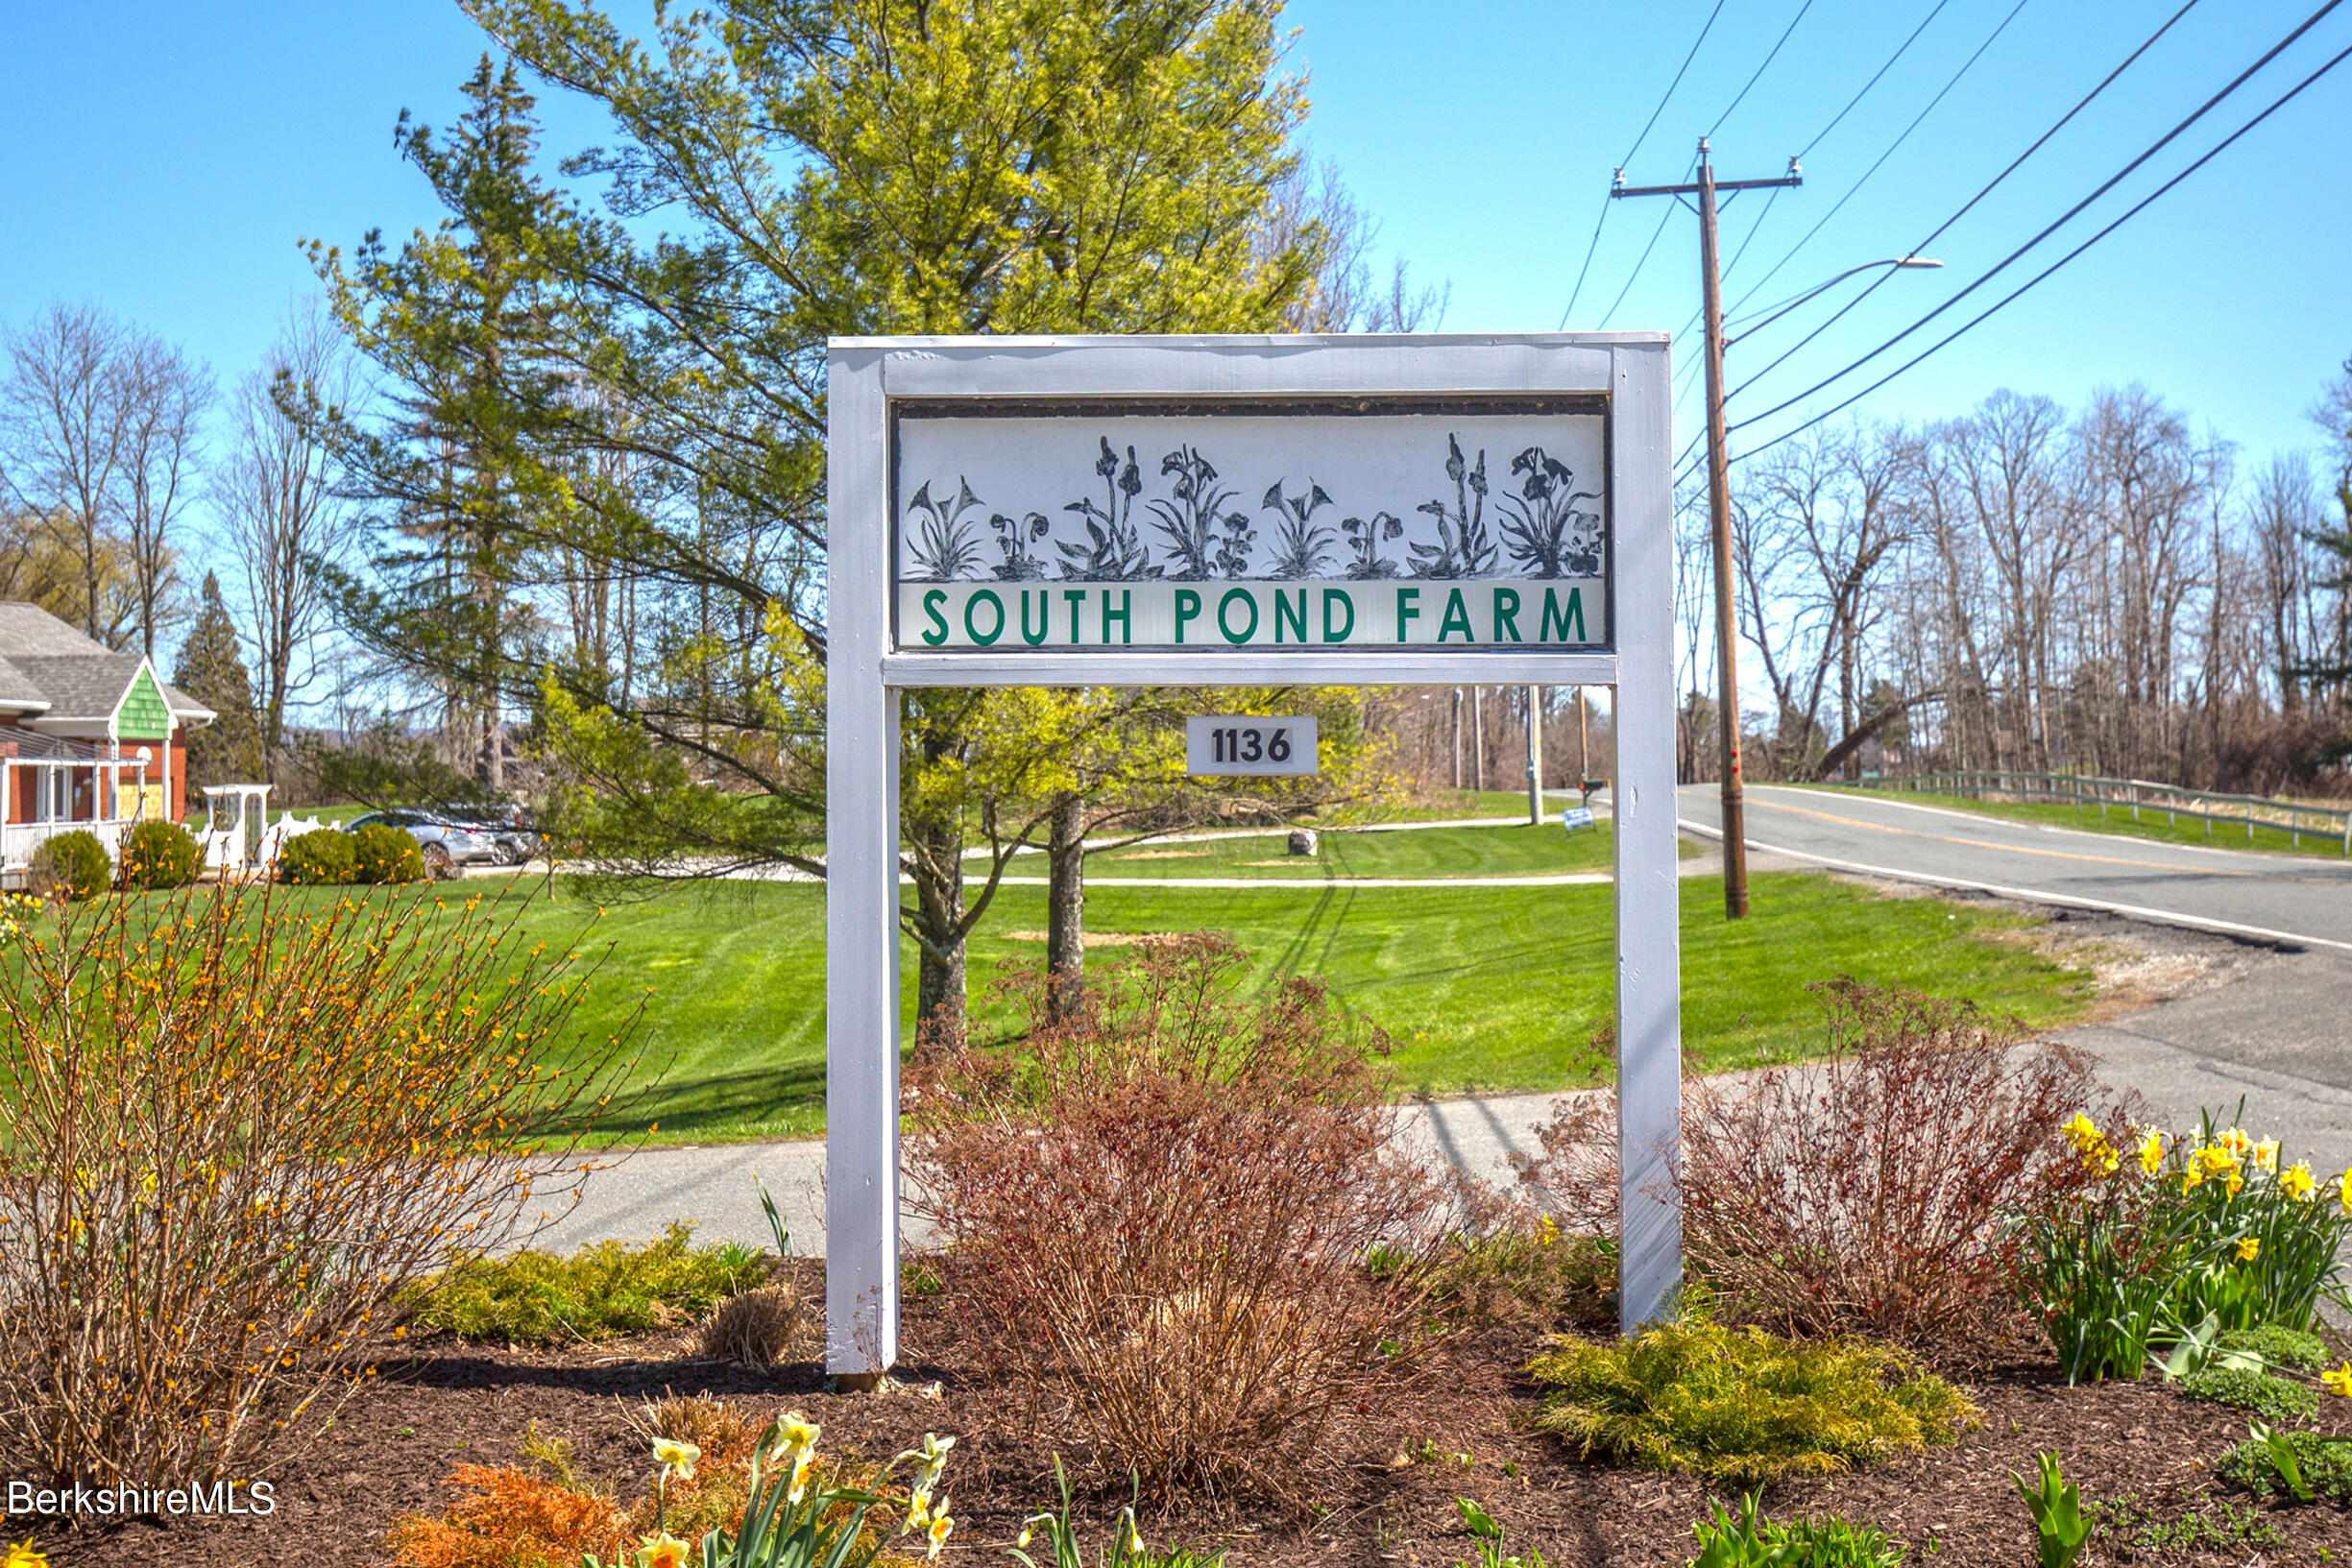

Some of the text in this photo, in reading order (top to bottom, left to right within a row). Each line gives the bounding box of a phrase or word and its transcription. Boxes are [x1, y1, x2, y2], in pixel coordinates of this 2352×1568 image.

[922, 588, 1587, 646] SOUTH POND FARM
[1211, 728, 1292, 763] 1136
